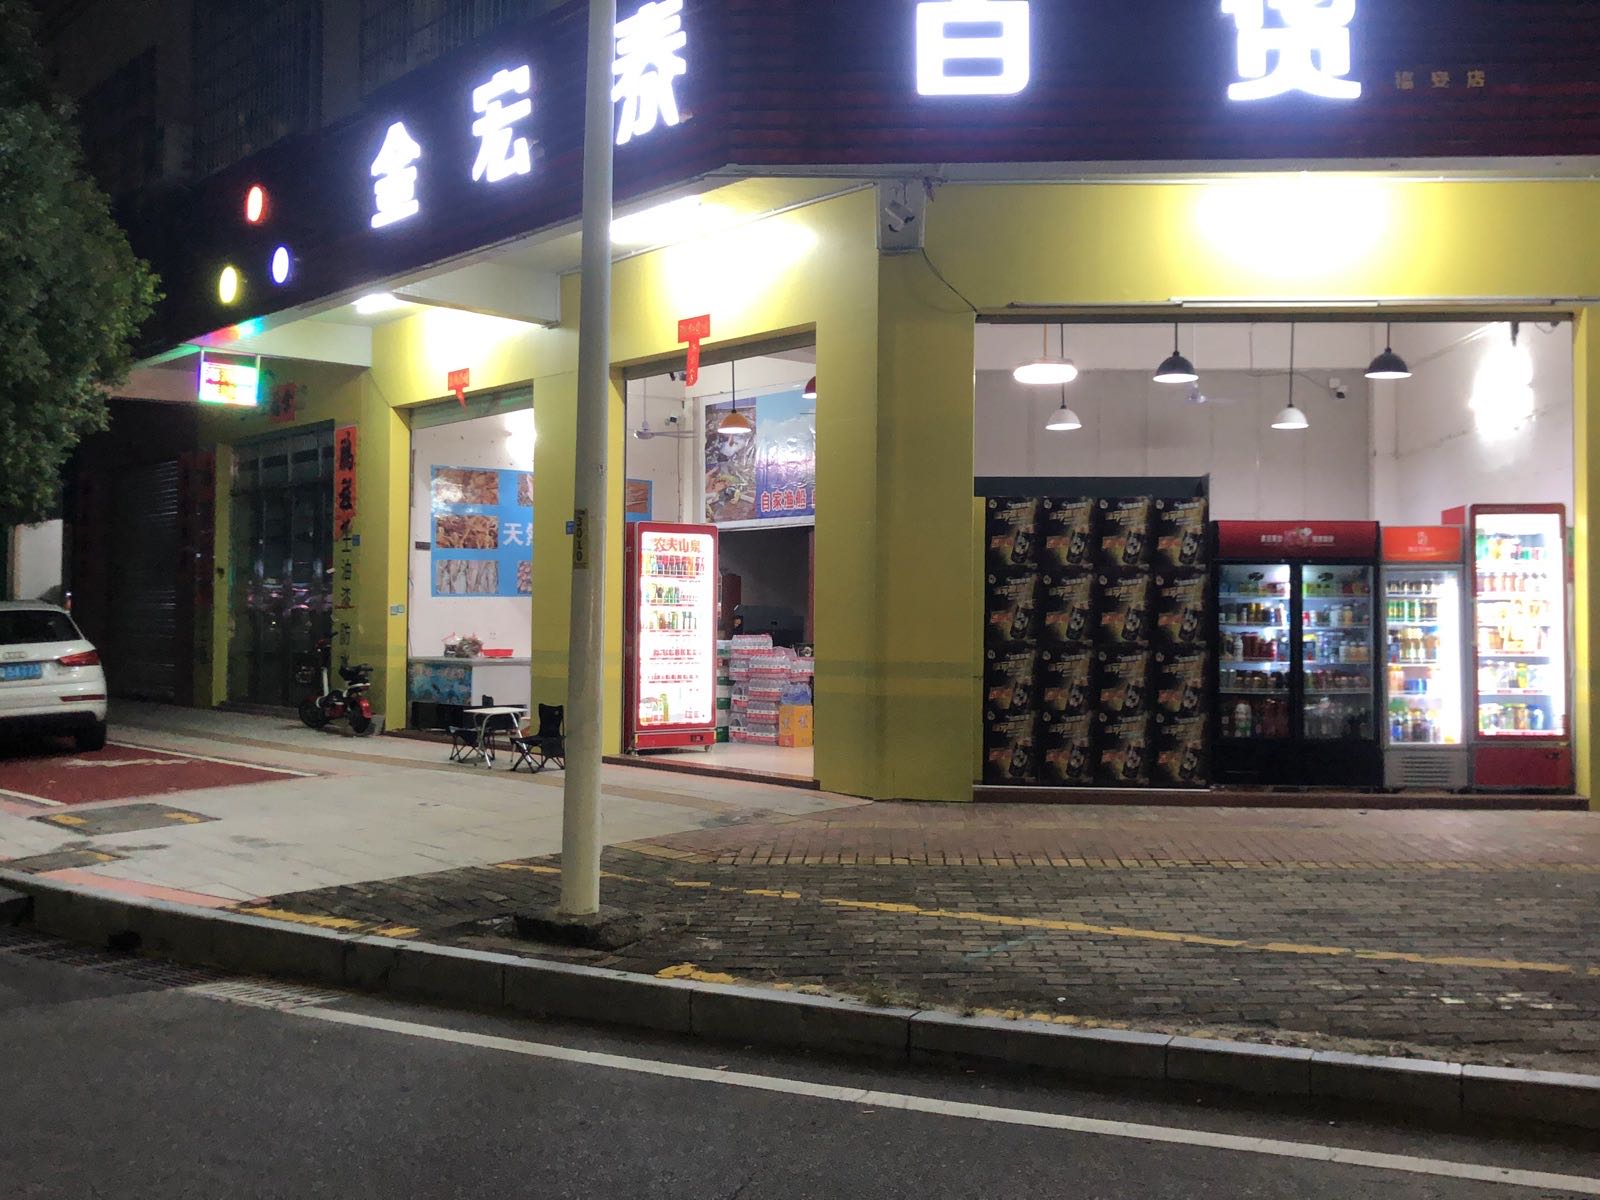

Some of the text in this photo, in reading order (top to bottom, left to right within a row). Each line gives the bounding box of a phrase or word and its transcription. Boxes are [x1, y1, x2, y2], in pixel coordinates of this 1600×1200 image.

[369, 0, 689, 230] 金宏泰
[654, 536, 702, 554] 农夫山泉
